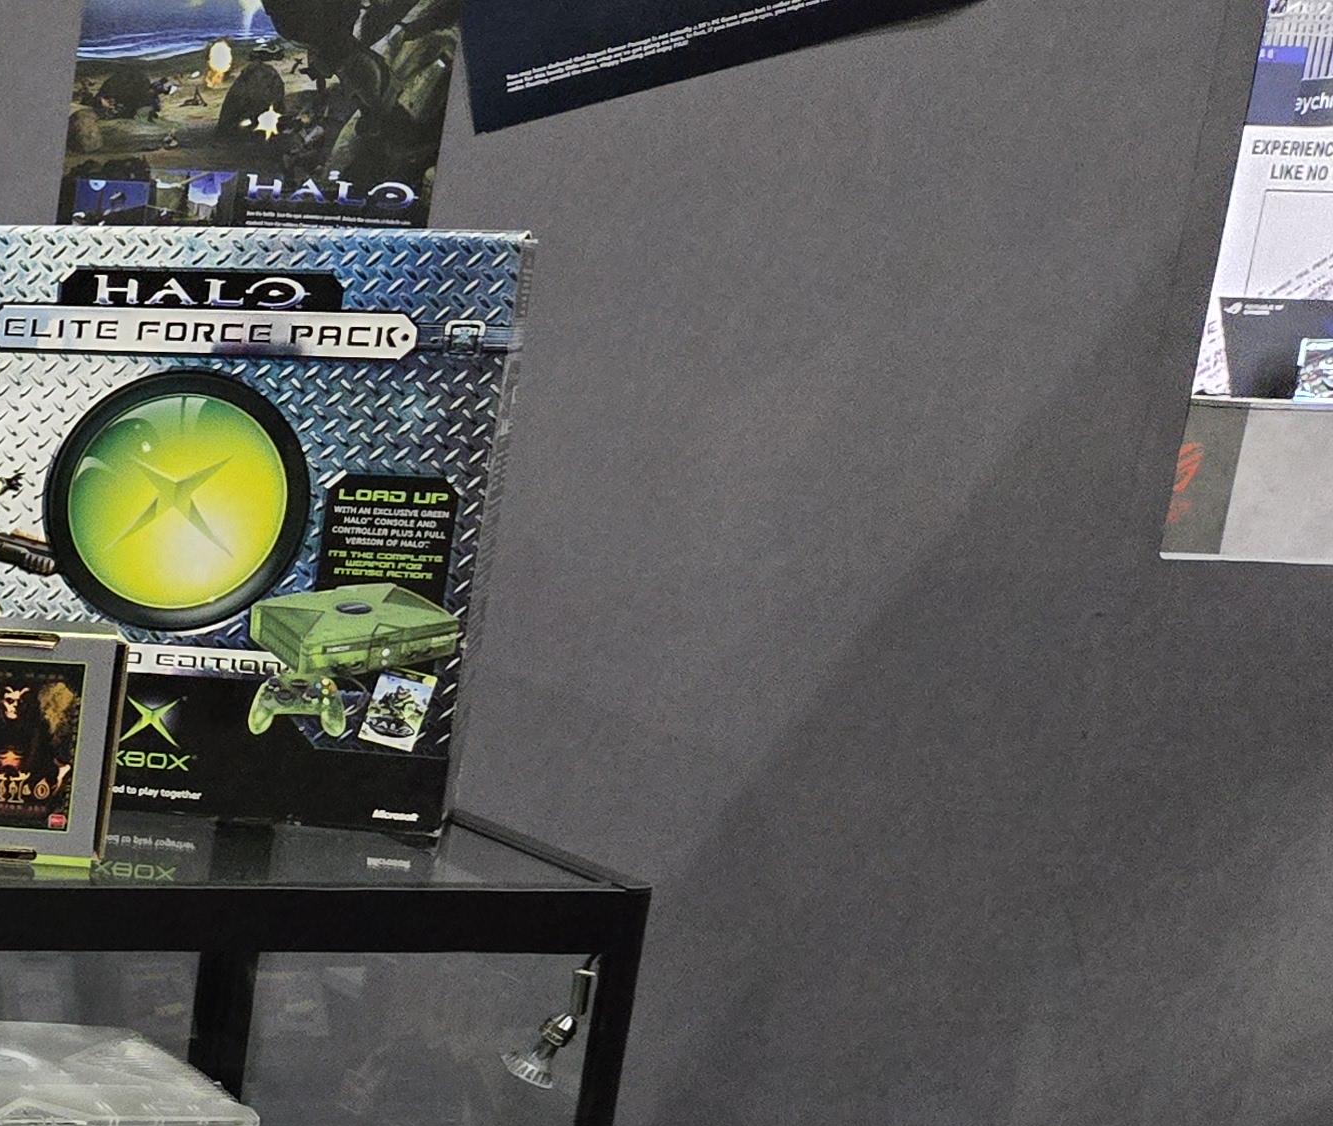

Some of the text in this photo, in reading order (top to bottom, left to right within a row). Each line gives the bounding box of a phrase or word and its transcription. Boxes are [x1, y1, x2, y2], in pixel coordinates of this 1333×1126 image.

[1270, 164, 1329, 180] LIKE NO
[246, 172, 419, 210] HALO
[92, 273, 311, 308] HALO
[4, 318, 400, 348] ELITE FORCE PACK
[338, 488, 449, 504] LOAD UP
[334, 505, 450, 519] WITH AN EXCLUSIVE GREEN
[374, 518, 414, 528] CONSOLE
[416, 519, 437, 529] AND
[332, 525, 446, 540] CONTROLLER PLUS A FULL
[345, 536, 384, 547] VERSION
[385, 538, 398, 547] OF
[350, 550, 444, 563] THE COMPLETE
[345, 559, 423, 571] WEAPON FOR
[333, 567, 433, 580] INTENSE ACTION!
[155, 652, 283, 677] EDITION
[126, 786, 203, 801] to play together
[372, 808, 420, 823] Microsoft
